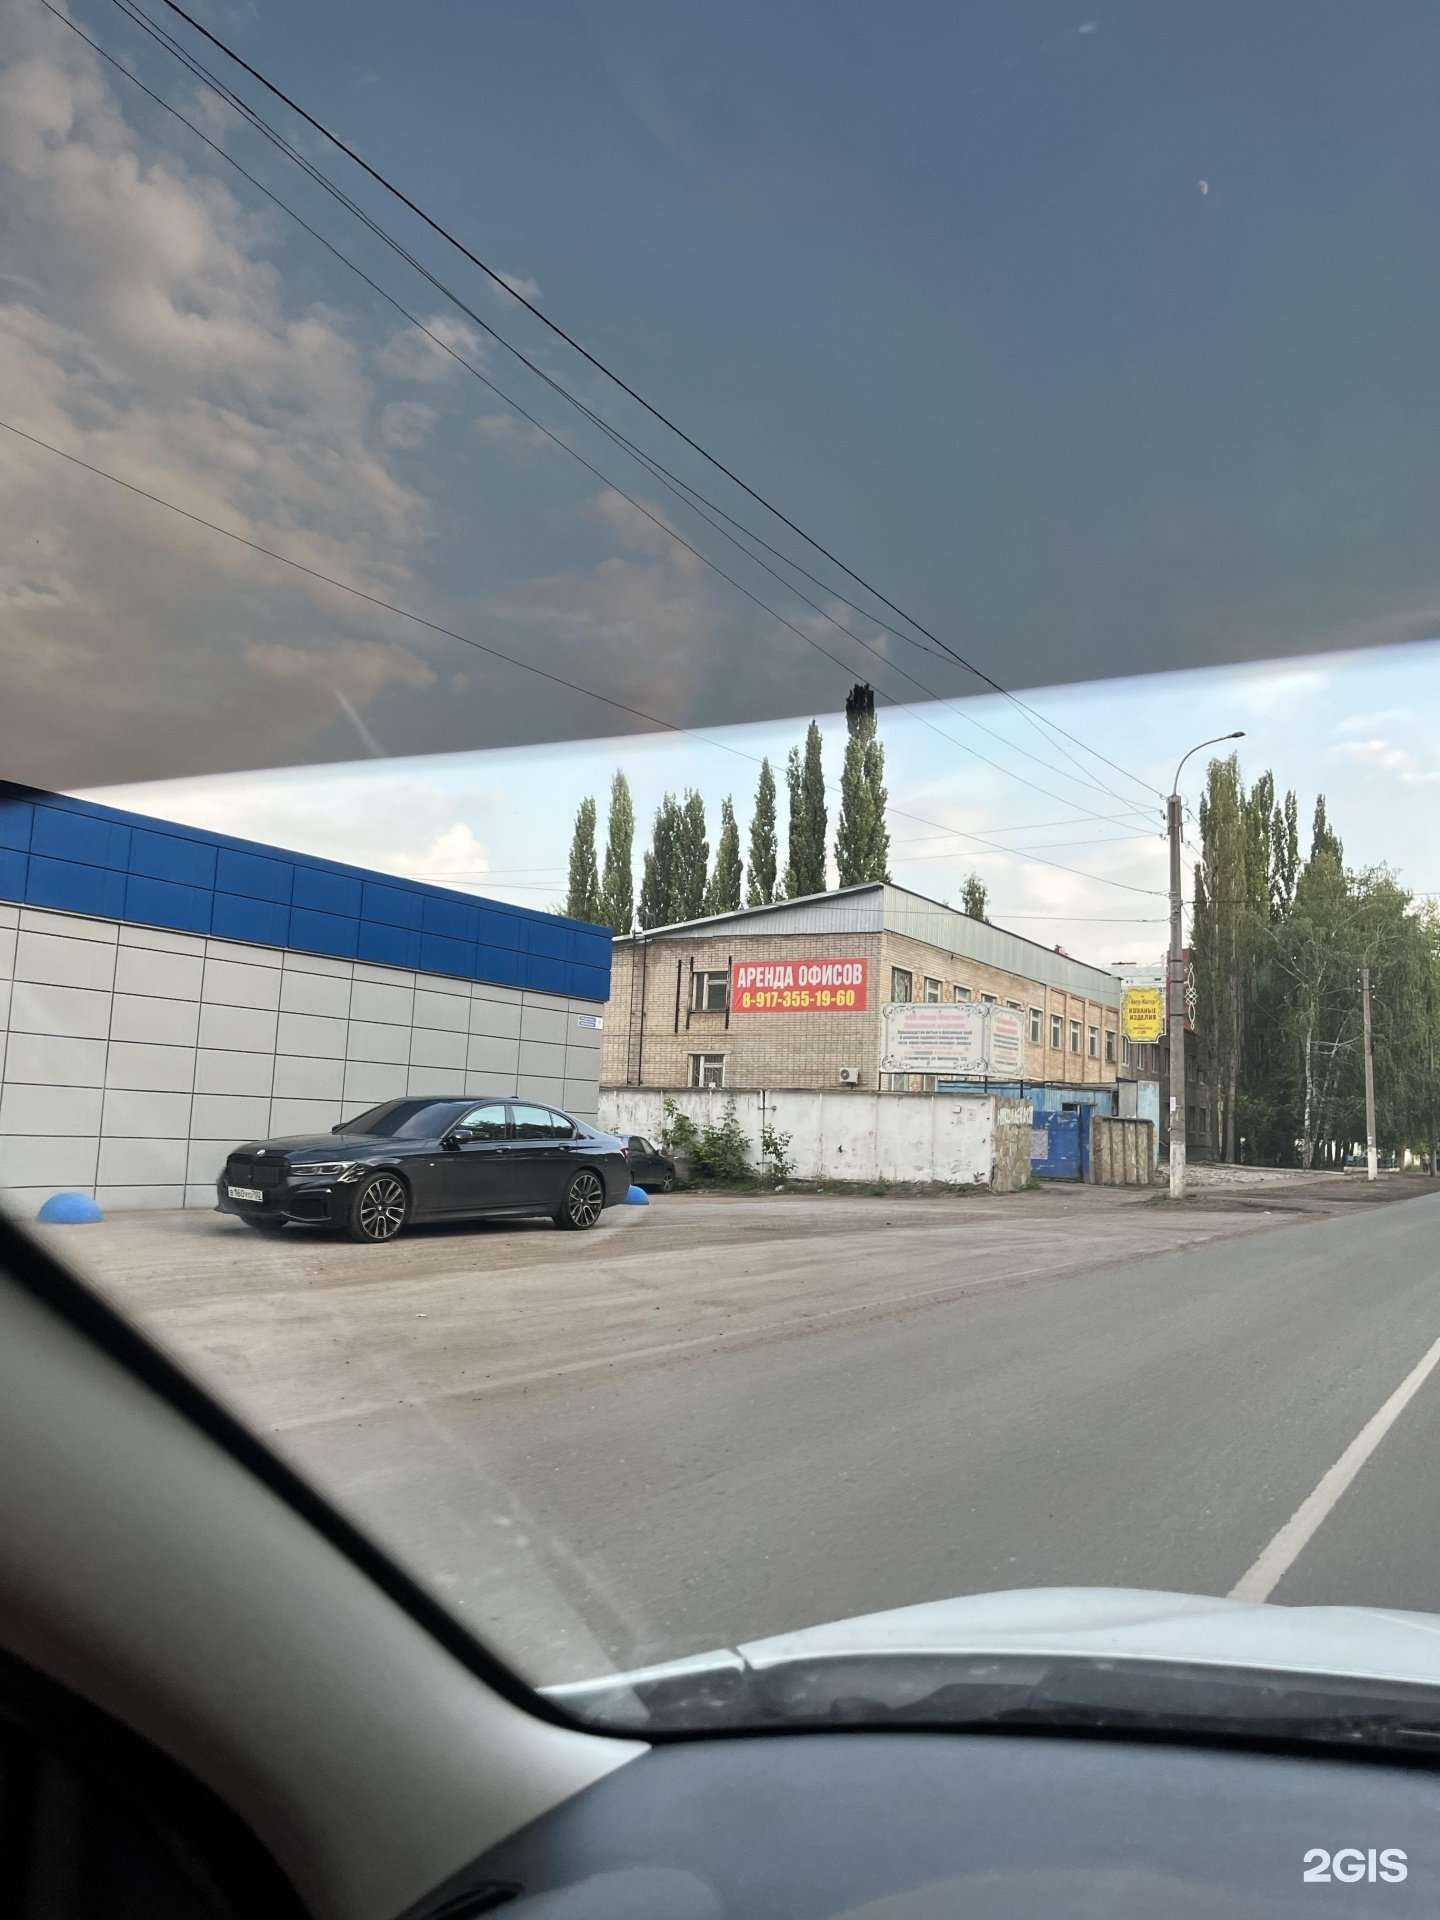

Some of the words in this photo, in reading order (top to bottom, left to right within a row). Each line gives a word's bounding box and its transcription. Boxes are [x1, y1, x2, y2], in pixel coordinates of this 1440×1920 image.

[737, 966, 794, 989] АРЕНДА
[798, 963, 863, 986] ОФИСОВ
[742, 990, 855, 1008] 8-917-355-19-60
